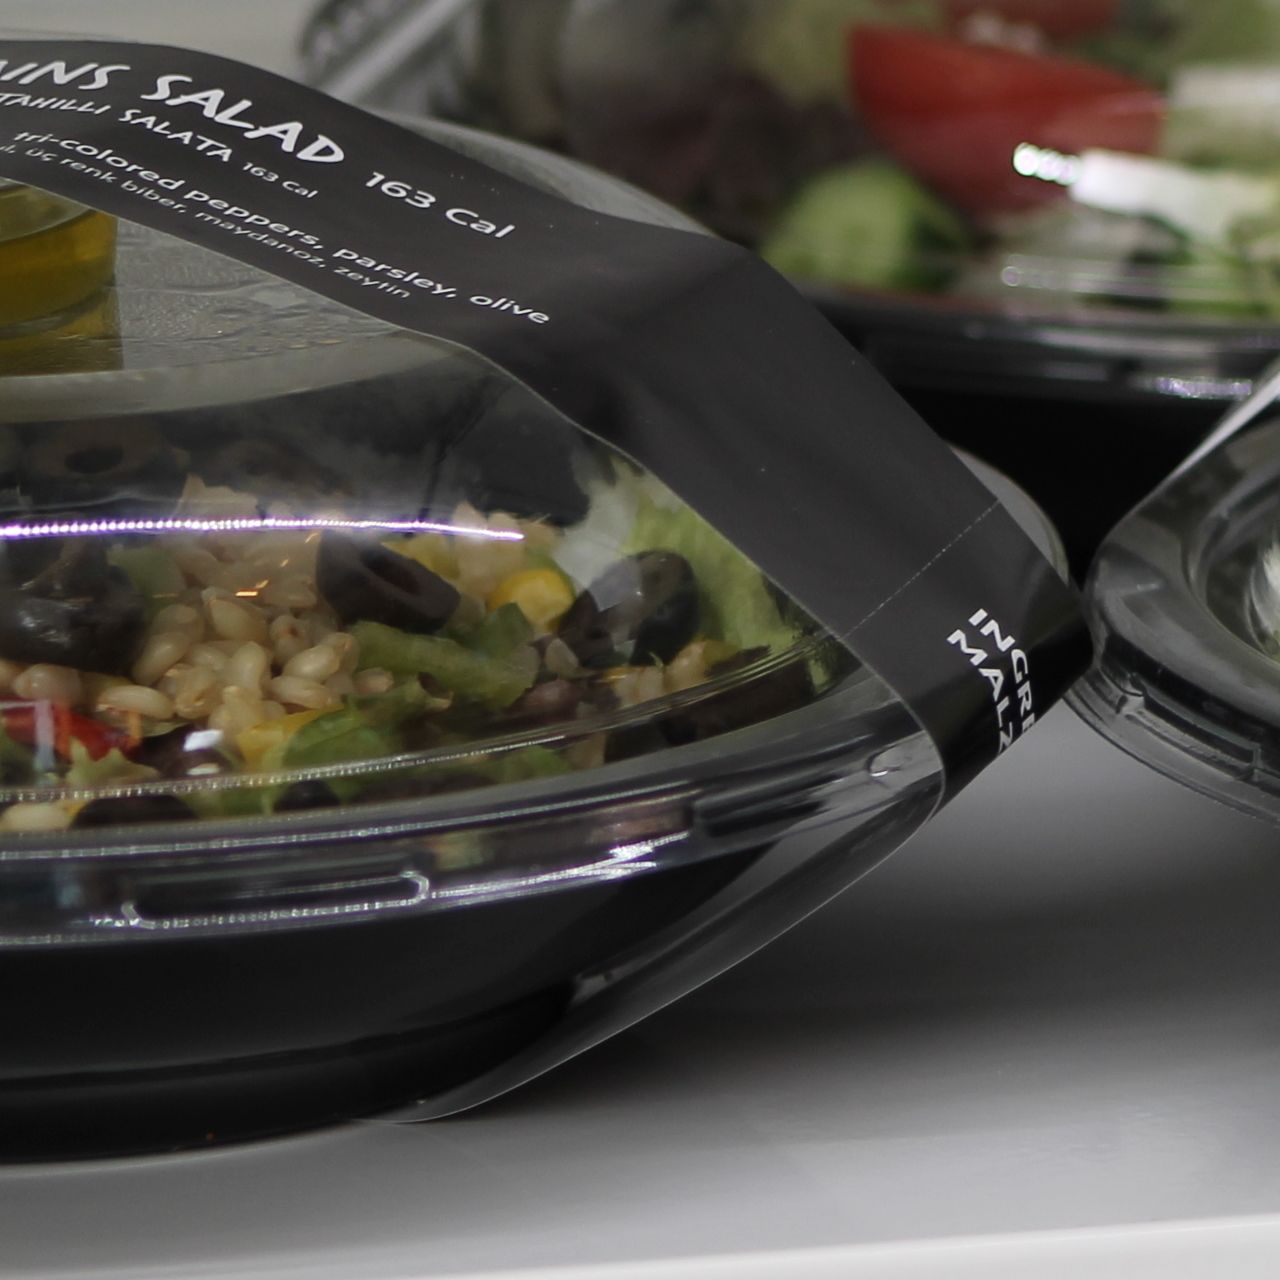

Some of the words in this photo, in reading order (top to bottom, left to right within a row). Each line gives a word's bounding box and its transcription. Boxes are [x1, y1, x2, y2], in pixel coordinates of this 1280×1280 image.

[0, 60, 130, 90] INS
[140, 75, 344, 162] SALAD
[365, 171, 436, 209] 163
[445, 208, 516, 238] Cal
[14, 131, 186, 191] tri-colored
[183, 190, 323, 250] peppers,
[333, 248, 457, 298] parsley,
[470, 295, 550, 324] olive
[60, 158, 117, 183] renk
[121, 179, 187, 213] biber,
[195, 212, 327, 268] maydanoz,
[334, 267, 411, 298] zeytin
[118, 109, 232, 162] SALATA
[243, 162, 279, 183] 163
[282, 180, 319, 198] Cal
